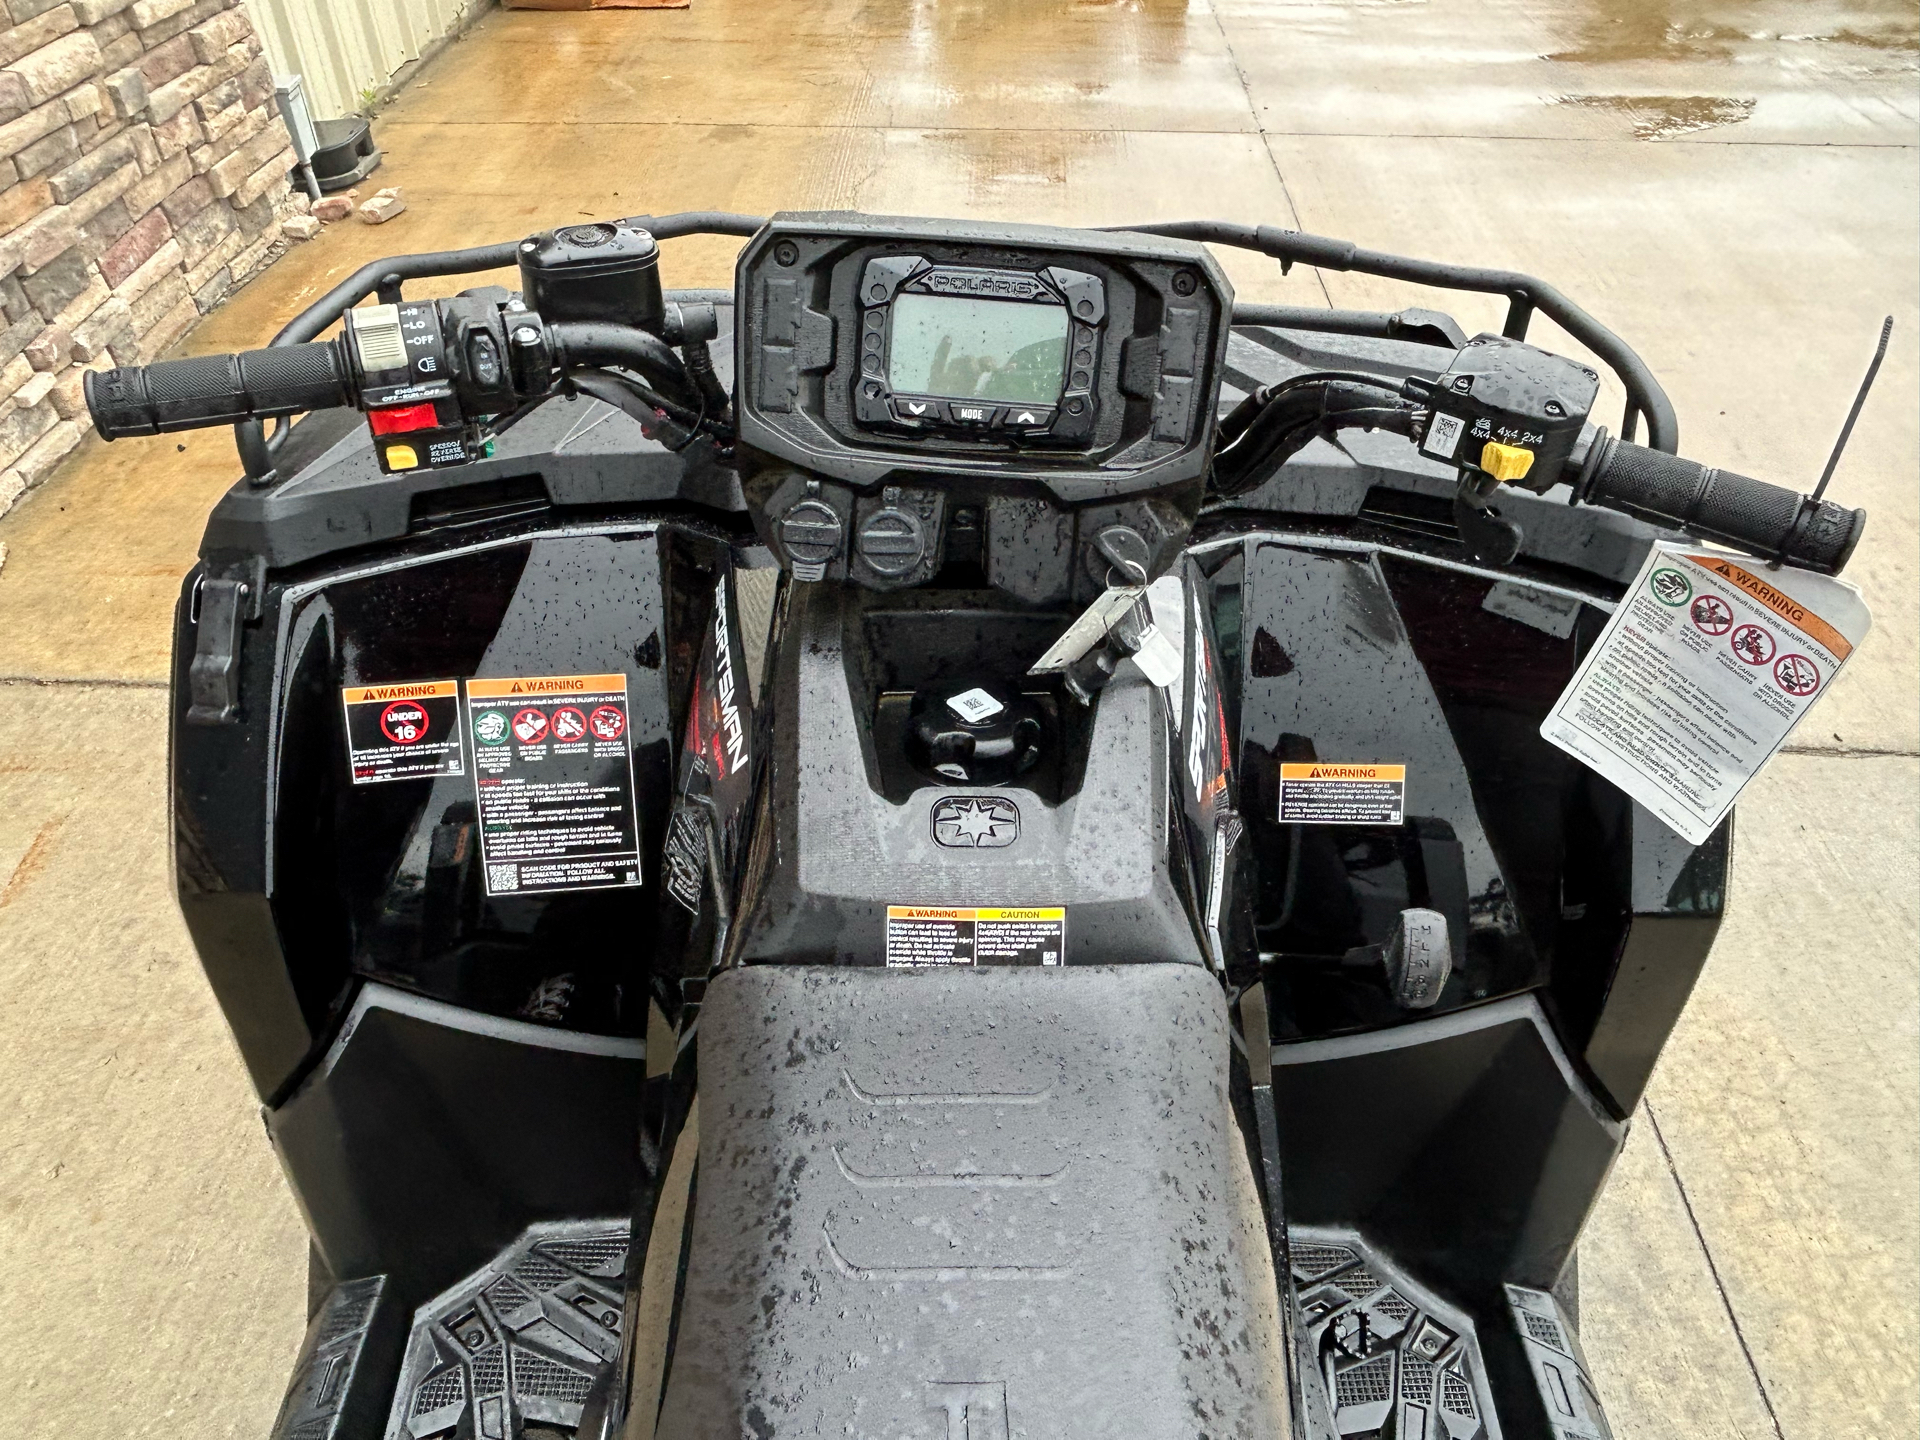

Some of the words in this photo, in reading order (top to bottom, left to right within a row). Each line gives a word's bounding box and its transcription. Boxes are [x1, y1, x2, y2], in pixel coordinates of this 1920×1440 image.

[410, 320, 426, 329] LO
[413, 334, 434, 345] OFF
[961, 408, 983, 420] MODE
[1733, 571, 1804, 621] WARNING
[715, 574, 748, 774] SPORTSMAN
[376, 685, 436, 698] WARNING
[526, 680, 583, 691] WARNING
[386, 710, 422, 722] UNDER
[394, 724, 416, 740] 16
[1321, 768, 1375, 777] WARNING
